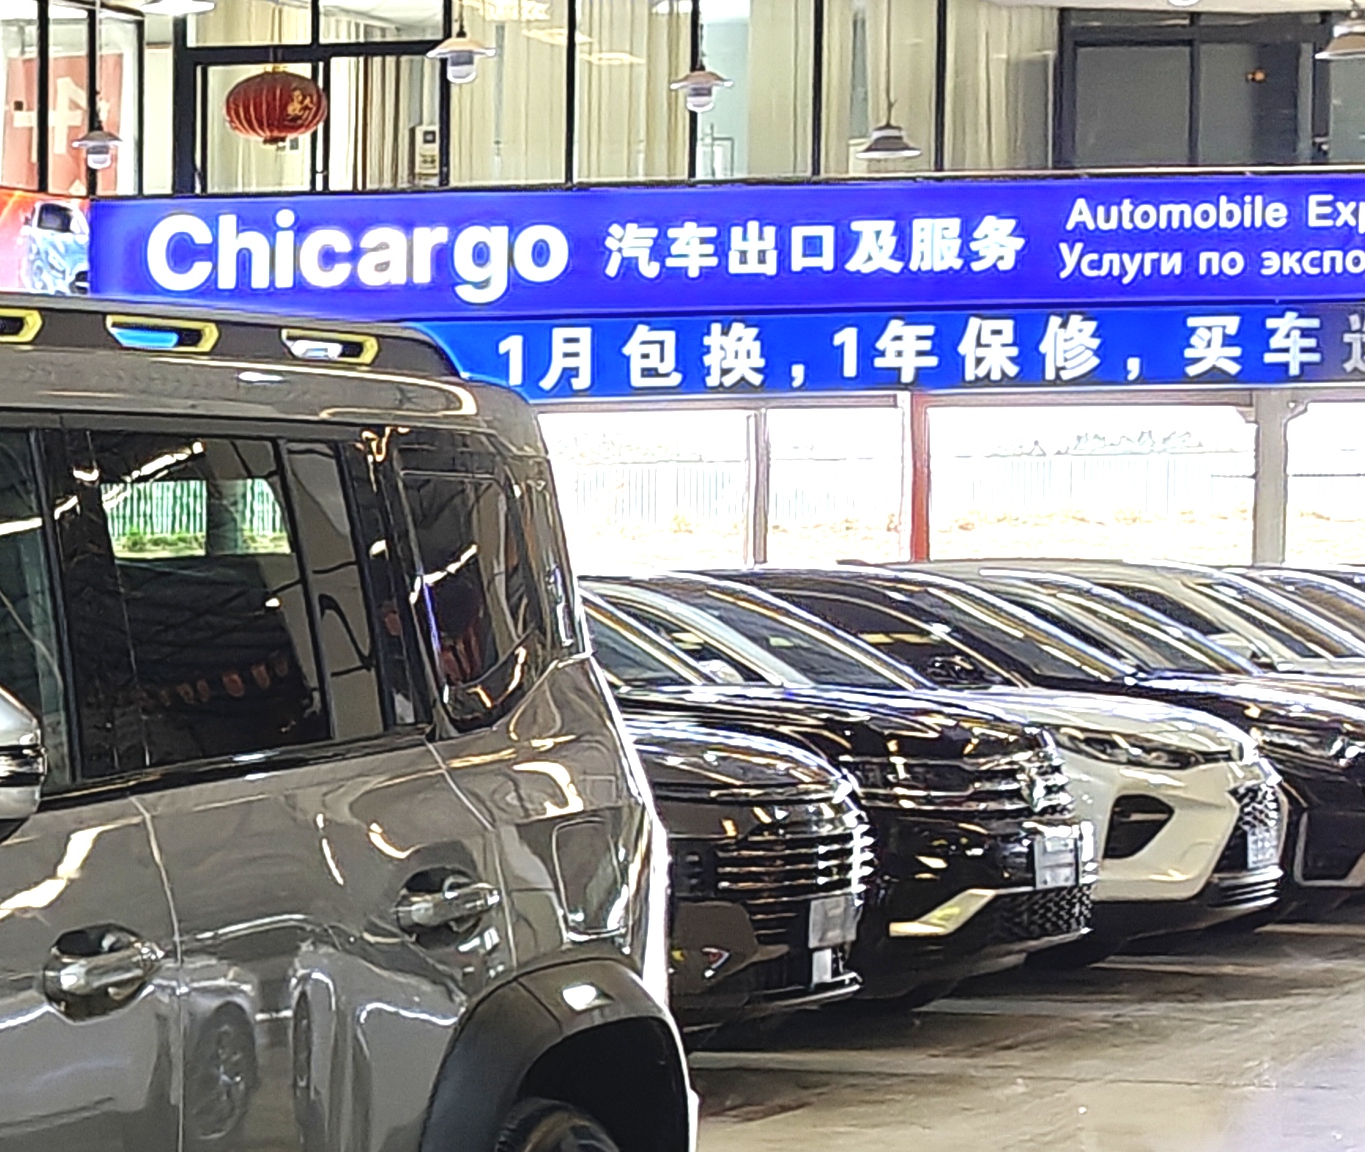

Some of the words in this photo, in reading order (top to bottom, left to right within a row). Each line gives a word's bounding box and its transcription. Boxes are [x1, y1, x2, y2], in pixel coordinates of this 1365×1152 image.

[1066, 195, 1287, 231] Automobile
[147, 209, 569, 303] Chicargo
[604, 216, 1025, 277] 汽车出口及服务
[1059, 243, 1182, 282] Услуги
[1199, 251, 1245, 276] по
